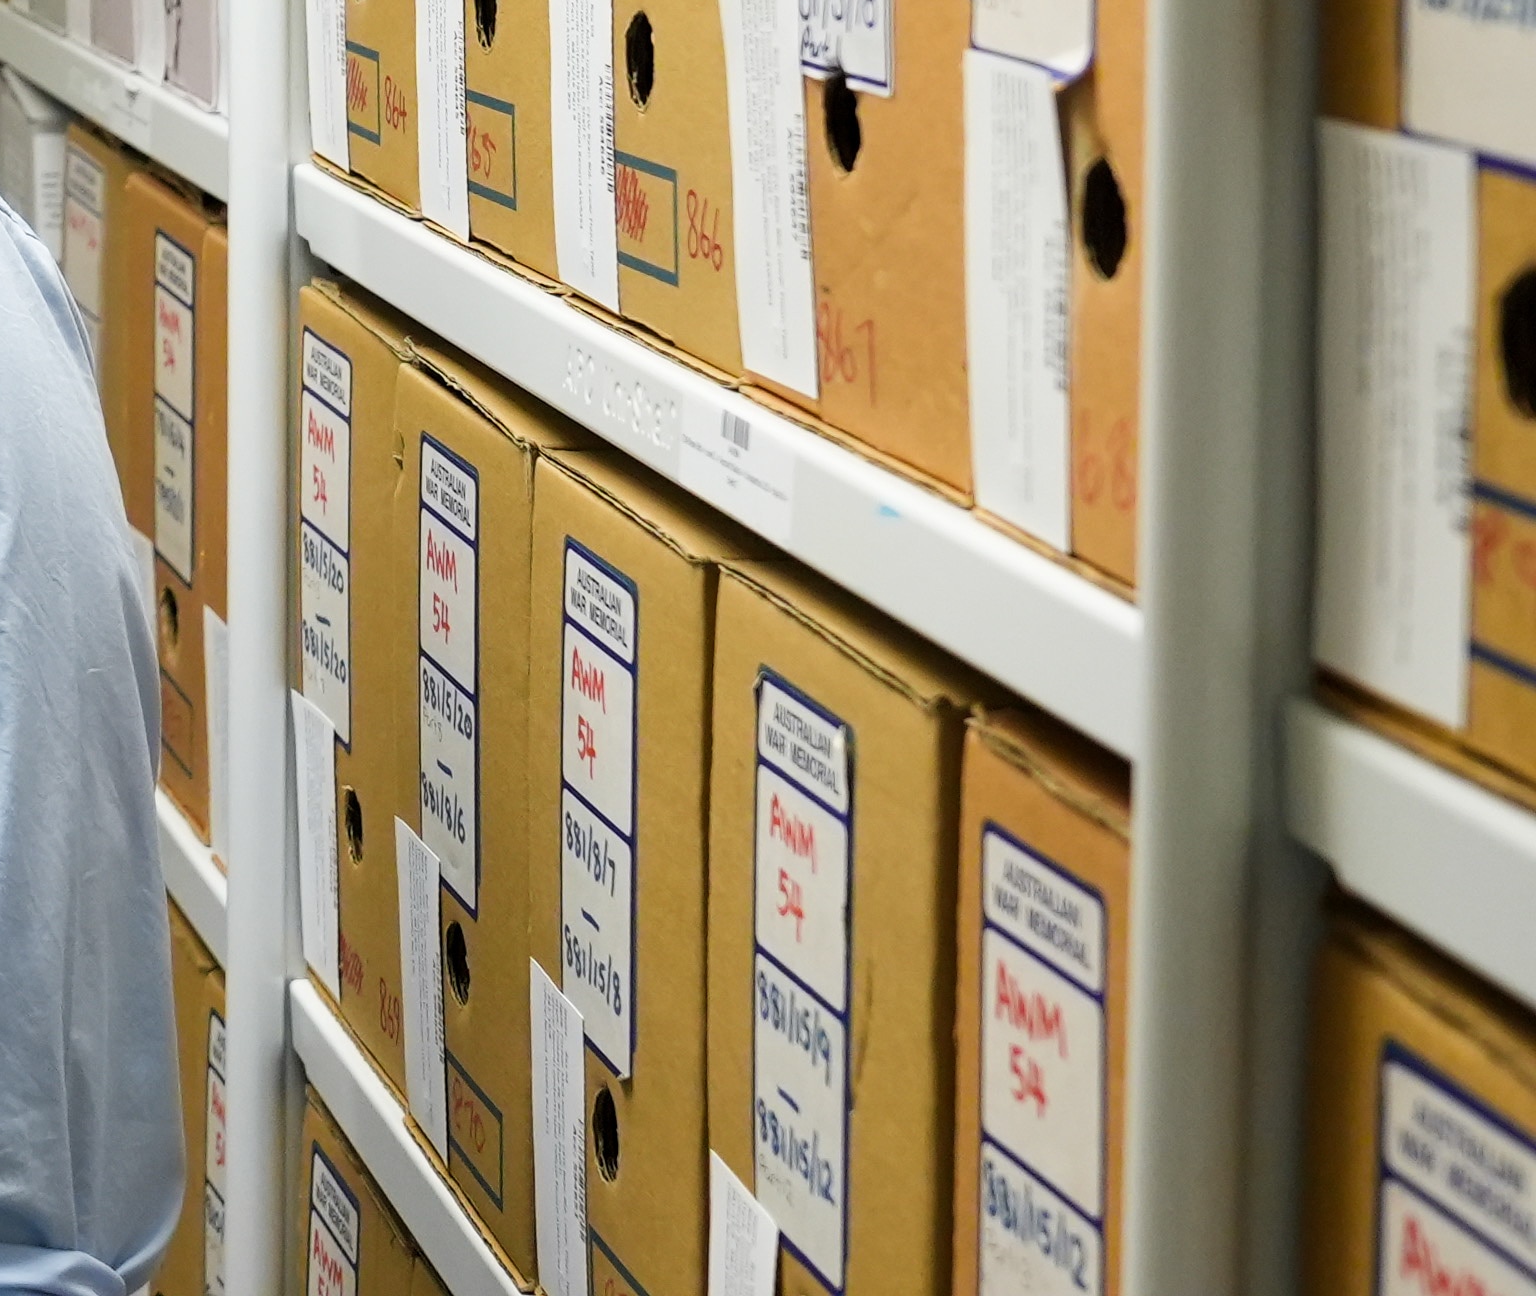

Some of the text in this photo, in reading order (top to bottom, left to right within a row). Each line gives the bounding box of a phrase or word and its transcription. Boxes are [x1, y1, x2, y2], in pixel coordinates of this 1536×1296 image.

[385, 76, 407, 134] 864
[685, 188, 723, 272] 866
[308, 407, 336, 462] AWM
[313, 463, 328, 516] 54
[425, 475, 472, 528] WAR MEMORIAL
[429, 458, 467, 502] AUSTRALIAN
[426, 527, 458, 593] AWM
[576, 567, 622, 618] AUSTRALIAN
[431, 593, 451, 645] 54
[570, 585, 628, 649] WAR MEMORIAL
[422, 668, 473, 742] 881/5/20
[571, 645, 607, 715] AWM
[576, 714, 597, 779] 54
[420, 771, 467, 845] 881/8/6
[769, 793, 819, 873] AWM
[564, 810, 616, 898] 881/8/7
[777, 868, 805, 942] 54
[563, 924, 623, 1017] 881/15/8
[756, 969, 833, 1086] 881/15/9
[994, 958, 1067, 1059] AWM
[1009, 1045, 1047, 1120] 54
[756, 1097, 836, 1207] 881/15/12
